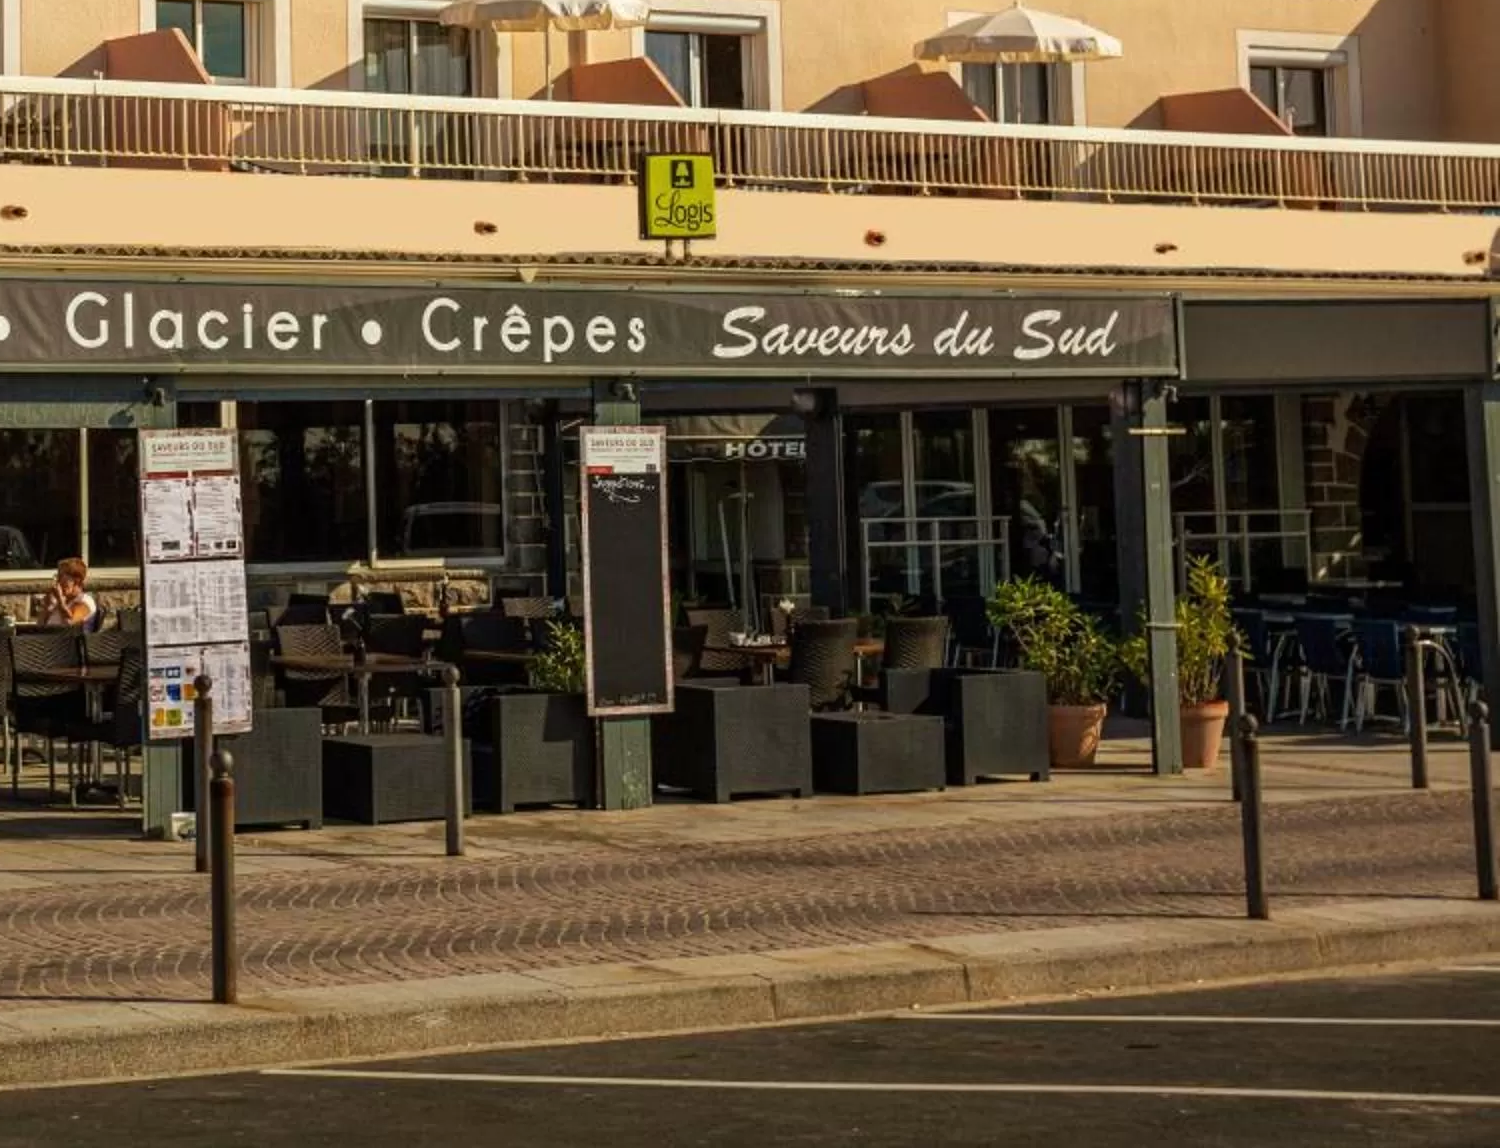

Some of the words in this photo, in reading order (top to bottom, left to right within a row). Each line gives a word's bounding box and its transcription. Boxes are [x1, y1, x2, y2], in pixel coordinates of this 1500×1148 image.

[654, 190, 713, 231] Logis
[65, 291, 329, 351] Glacier
[420, 297, 647, 363] Crêpes
[712, 306, 915, 358] Saveurs
[933, 310, 995, 358] du
[1012, 309, 1120, 361] Sud
